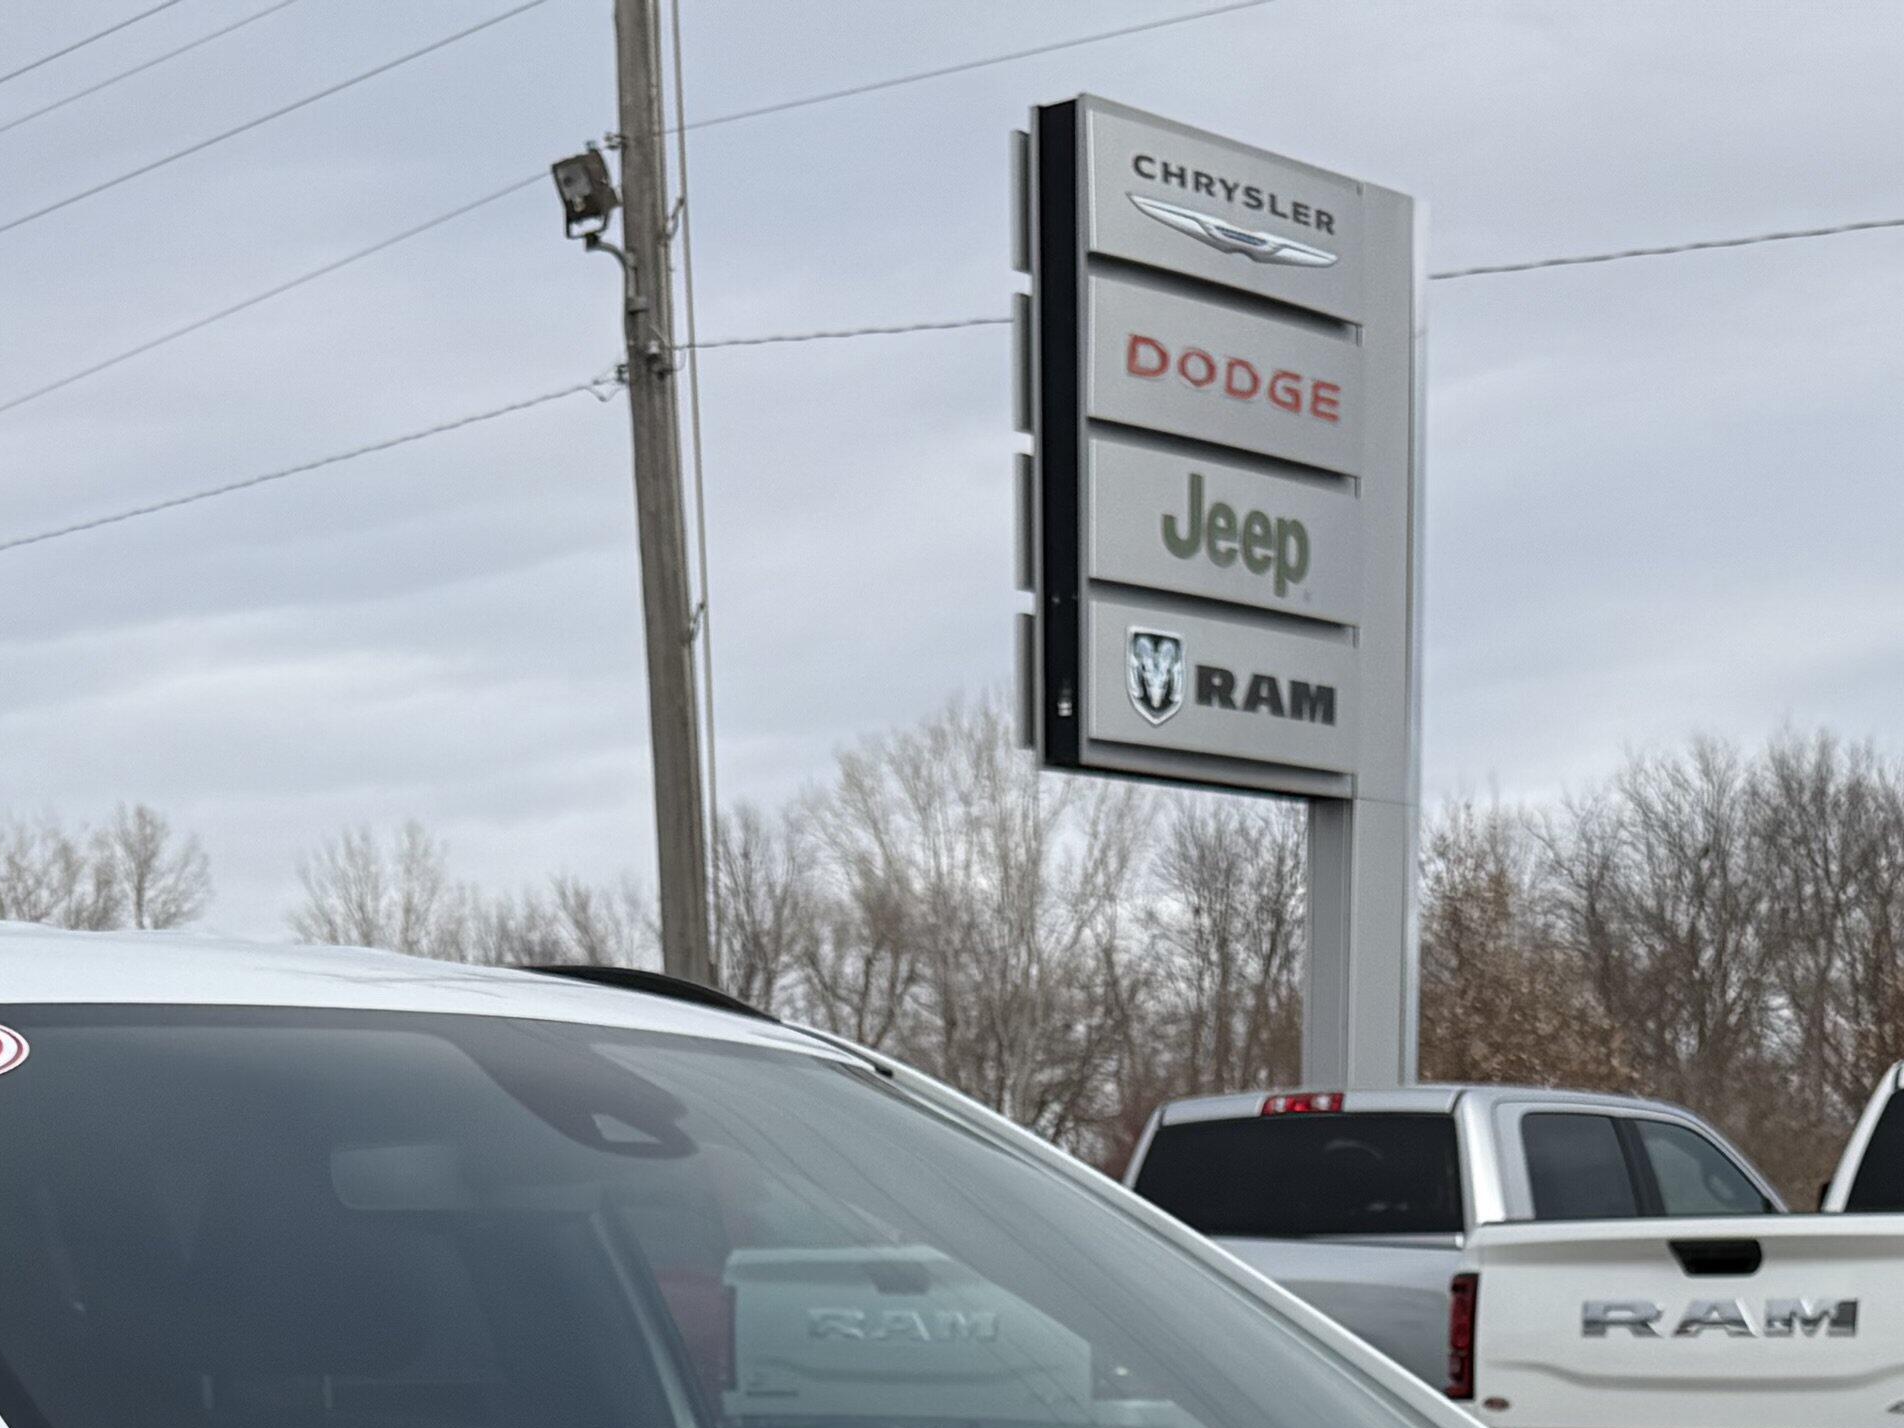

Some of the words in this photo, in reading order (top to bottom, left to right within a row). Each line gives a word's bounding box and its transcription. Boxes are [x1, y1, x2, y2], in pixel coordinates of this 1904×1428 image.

[1132, 153, 1337, 237] CHRYSLER
[1125, 333, 1343, 424] DODGE
[1161, 472, 1311, 598] Jeep
[1195, 663, 1338, 727] RAM
[806, 1307, 1000, 1343] RAM
[1581, 1296, 1860, 1338] RAM
